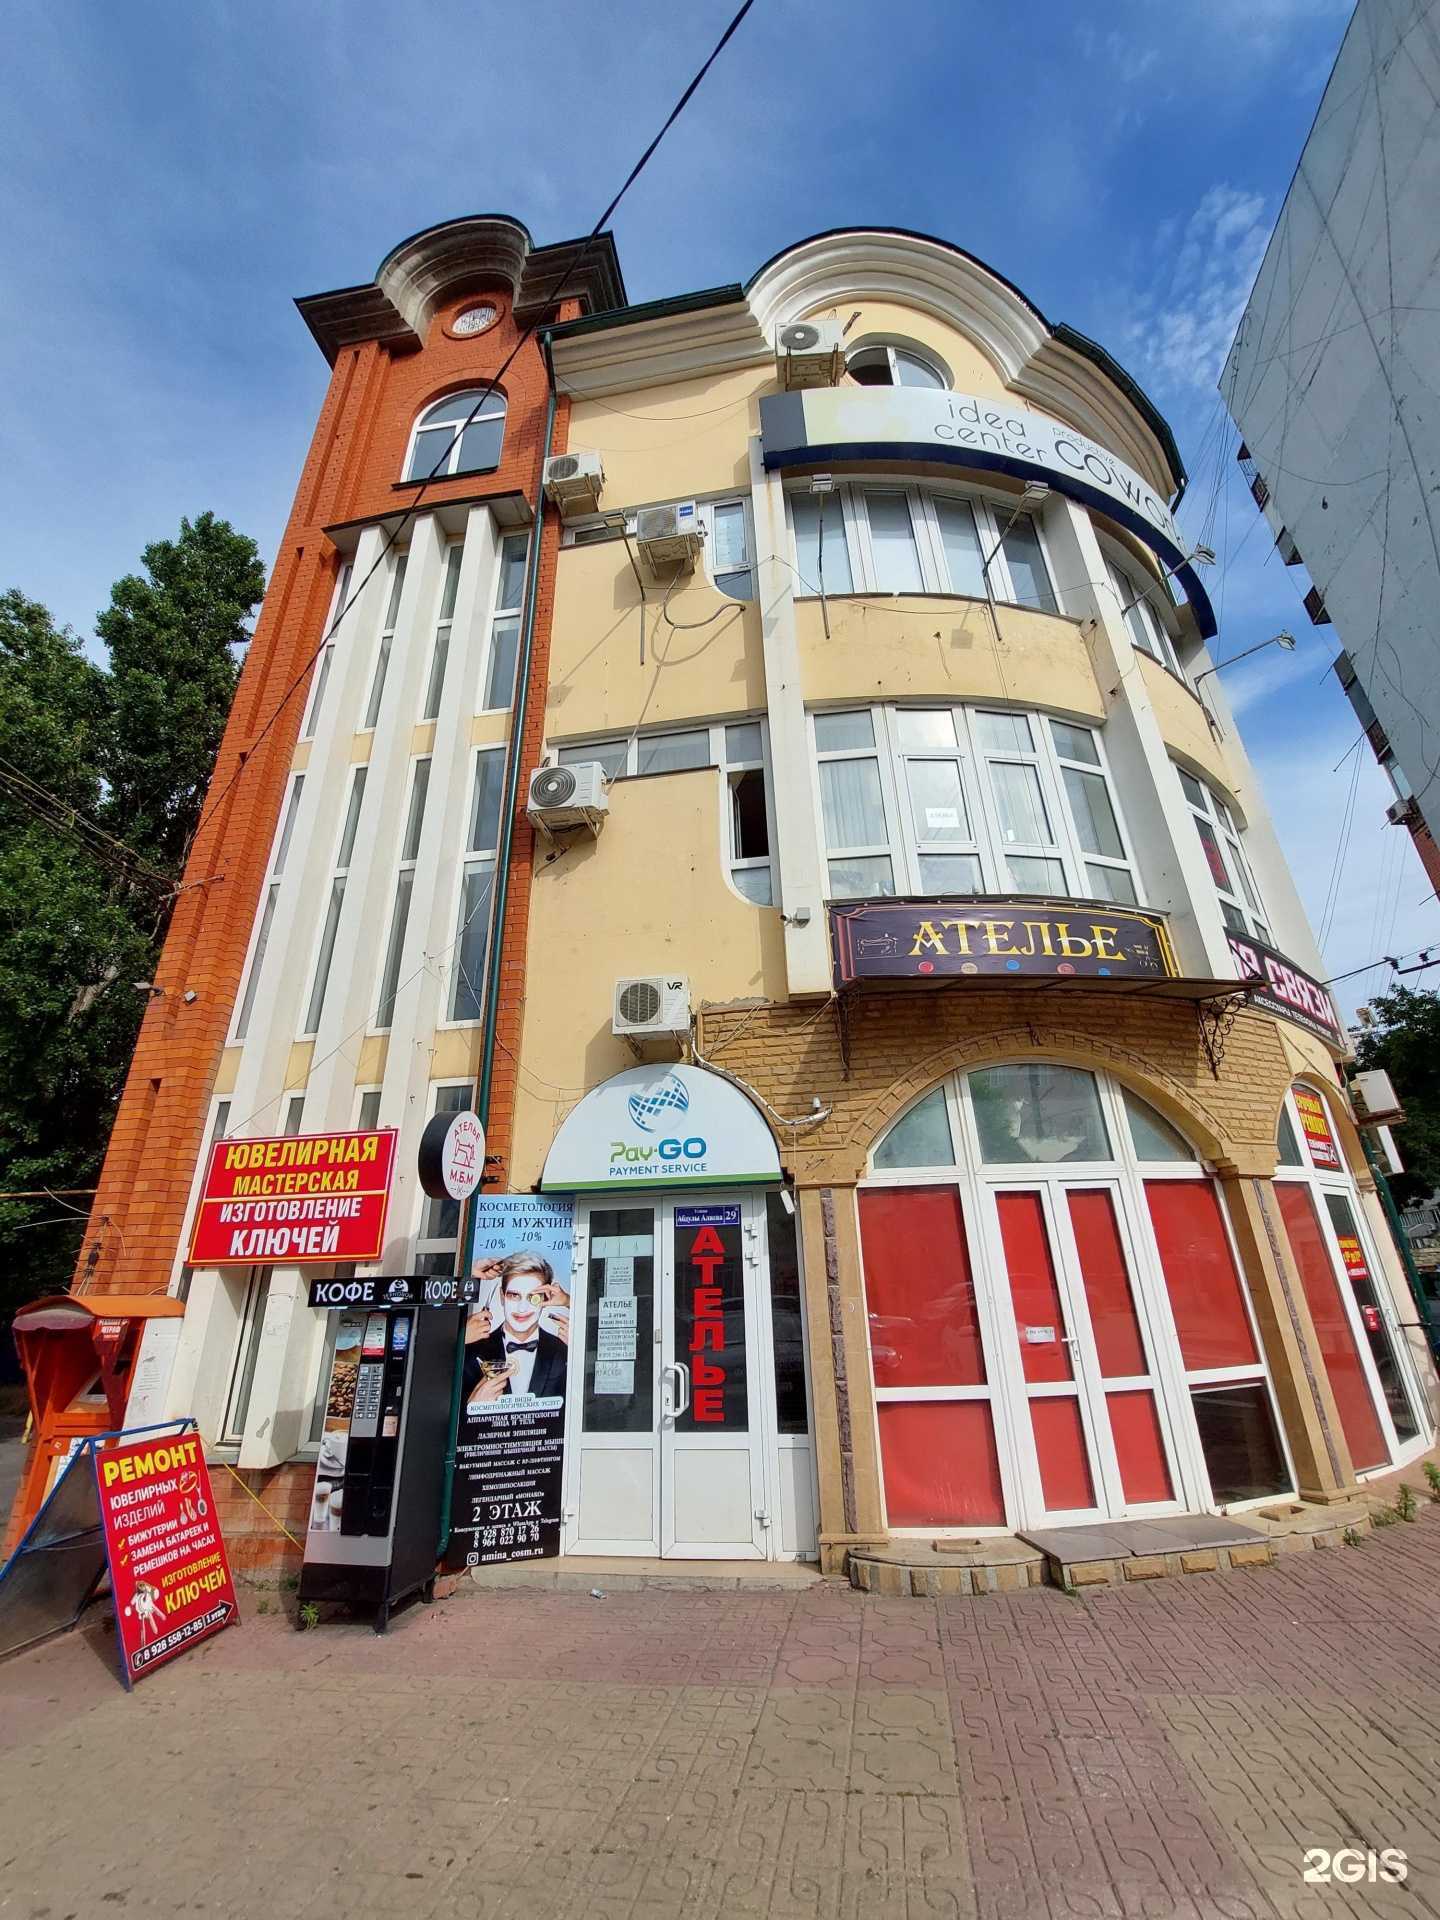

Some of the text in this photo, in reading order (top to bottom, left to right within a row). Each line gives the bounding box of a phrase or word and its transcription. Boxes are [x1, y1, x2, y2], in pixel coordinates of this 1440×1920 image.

[947, 399, 1026, 437] idea
[934, 424, 1047, 462] center
[907, 920, 1127, 961] АТЕЛЬЕ
[666, 981, 682, 990] VR
[1264, 955, 1338, 1030] СВЯЗИ
[454, 1121, 480, 1142] АТЕЛЬЕ
[225, 1136, 379, 1170] ЮВЕЛИРНАЯ
[609, 1163, 707, 1176] PAYMENT SERVICE
[233, 1170, 359, 1196] МАСТЕРСКАЯ
[220, 1198, 362, 1223] ИЗГОТОВЛЕНИЕ
[480, 1202, 573, 1212] КОСМЕТОЛОГИЯ
[477, 1217, 573, 1229] ДЛЯ МУЖЧИН
[230, 1220, 340, 1257] КЛЮЧЕЙ
[480, 1238, 506, 1249] -10%
[516, 1231, 542, 1242] -10%
[547, 1240, 572, 1251] -10%
[315, 1281, 375, 1303] КОФЕ
[424, 1281, 458, 1300] КОФЕ
[689, 1226, 727, 1422] АТЕЛЬЕ
[467, 1411, 560, 1424] АППАРАТНАЯ КОСМЕТОЛОГИЯ
[103, 1441, 197, 1487] РЕМОНТ
[110, 1478, 179, 1511] ЮВЕЛИРНЫХ
[113, 1499, 166, 1531] ИЗДЕЛИЙ
[472, 1500, 542, 1522] 2 ЭТАЖ
[127, 1519, 178, 1546] БИЖУТЕРИИ
[130, 1521, 209, 1560] ЗАМЕНА БАТАРЕЕК И
[473, 1533, 539, 1548] 8 964 022 90 70
[474, 1525, 539, 1539] 8 928 870 17 26
[133, 1533, 216, 1577] РЕМЕШКОВ НА ЧАСАХ
[481, 1547, 544, 1560] amina_cosm.ru
[161, 1551, 222, 1588] ИЗГОТОВЛЕНИЕ
[164, 1564, 227, 1614] КЛЮЧЕЙ
[143, 1649, 151, 1660] 8
[151, 1640, 167, 1656] 928
